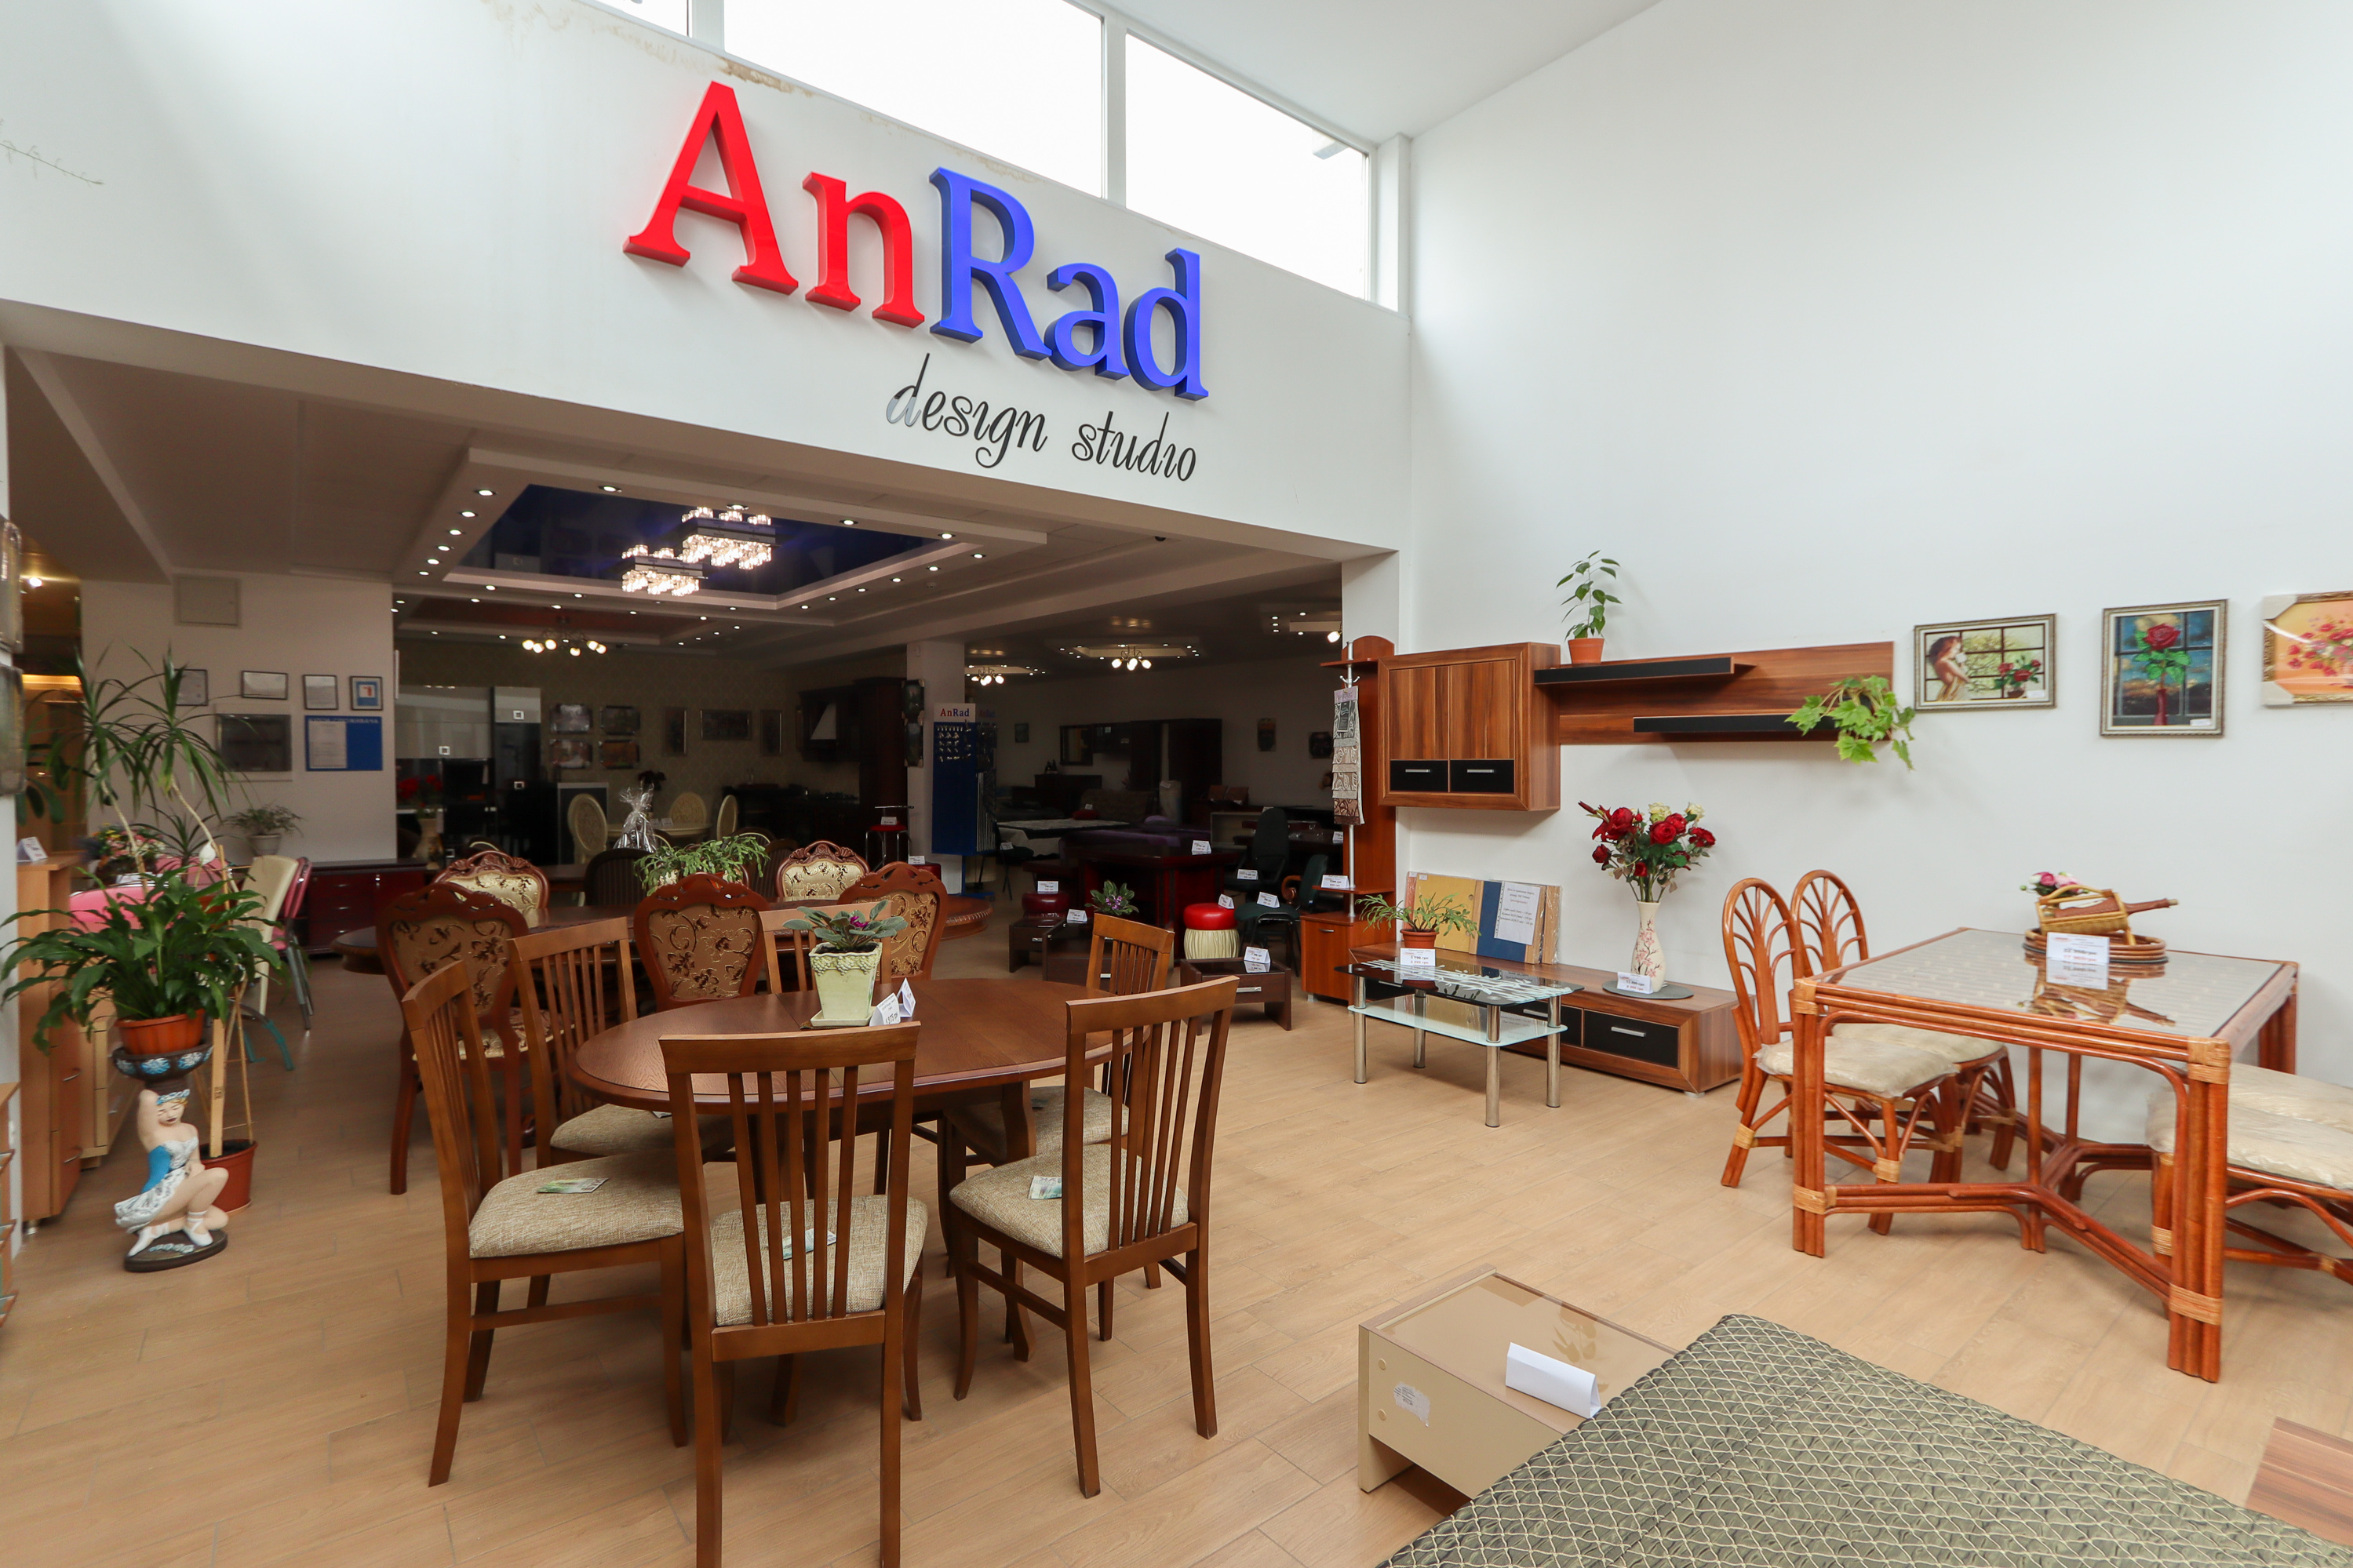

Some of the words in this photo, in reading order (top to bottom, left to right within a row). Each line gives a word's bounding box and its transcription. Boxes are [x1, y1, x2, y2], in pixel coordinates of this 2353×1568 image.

[623, 81, 1209, 402] AnRad
[887, 353, 1047, 468] design
[1072, 411, 1197, 482] studio
